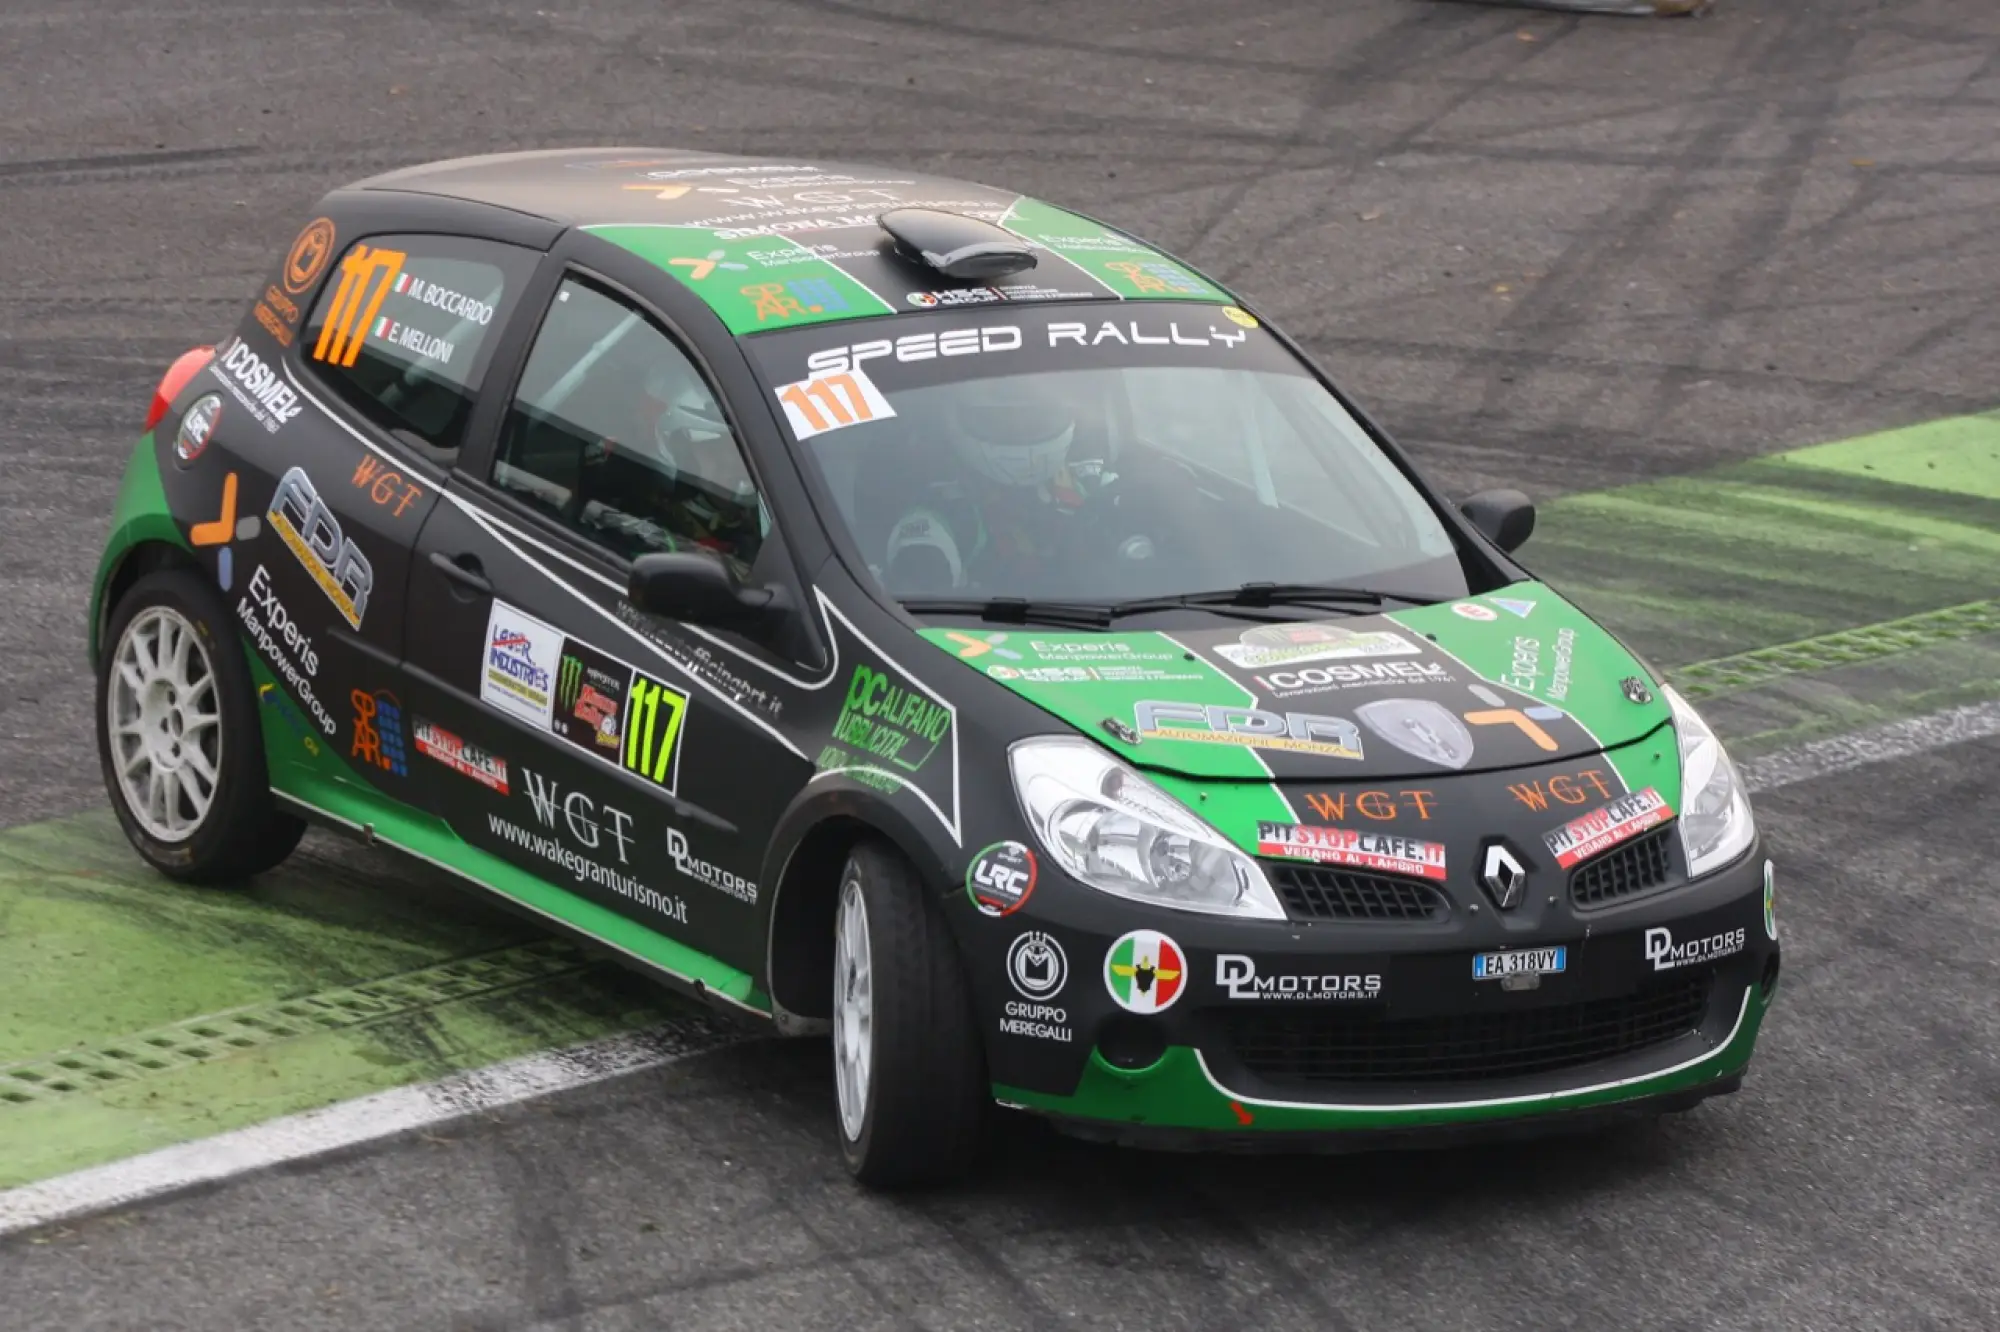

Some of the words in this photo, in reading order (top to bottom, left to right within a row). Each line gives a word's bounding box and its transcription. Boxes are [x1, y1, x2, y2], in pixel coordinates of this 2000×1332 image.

[313, 244, 407, 367] 117
[807, 325, 1023, 380] SPEED
[1047, 320, 1247, 350] RALLY
[781, 371, 874, 432] 117
[351, 453, 423, 519] WGT
[248, 563, 320, 678] Experis
[236, 596, 337, 736] ManpowerGroup
[1029, 640, 1131, 656] Experis
[630, 677, 686, 783] 117
[1304, 790, 1438, 822] WGT
[1506, 769, 1612, 813] WGT
[520, 766, 636, 865] WGT
[1258, 822, 1446, 866] PITSTOPCAFE.IT
[1282, 846, 1342, 863] VEDANO
[1344, 852, 1363, 865] AL
[1365, 856, 1425, 875] LAMBRO
[486, 811, 689, 926] www.wakegranturismo.it
[686, 853, 759, 902] MOTORS
[975, 859, 1029, 896] LRC
[1485, 955, 1505, 975] EA
[1508, 950, 1555, 973] 318VY
[1670, 927, 1746, 960] MOTORS
[1253, 974, 1382, 992] MOTORS
[998, 1016, 1073, 1043] MEREGALLI
[1004, 1000, 1067, 1024] GRUPPO
